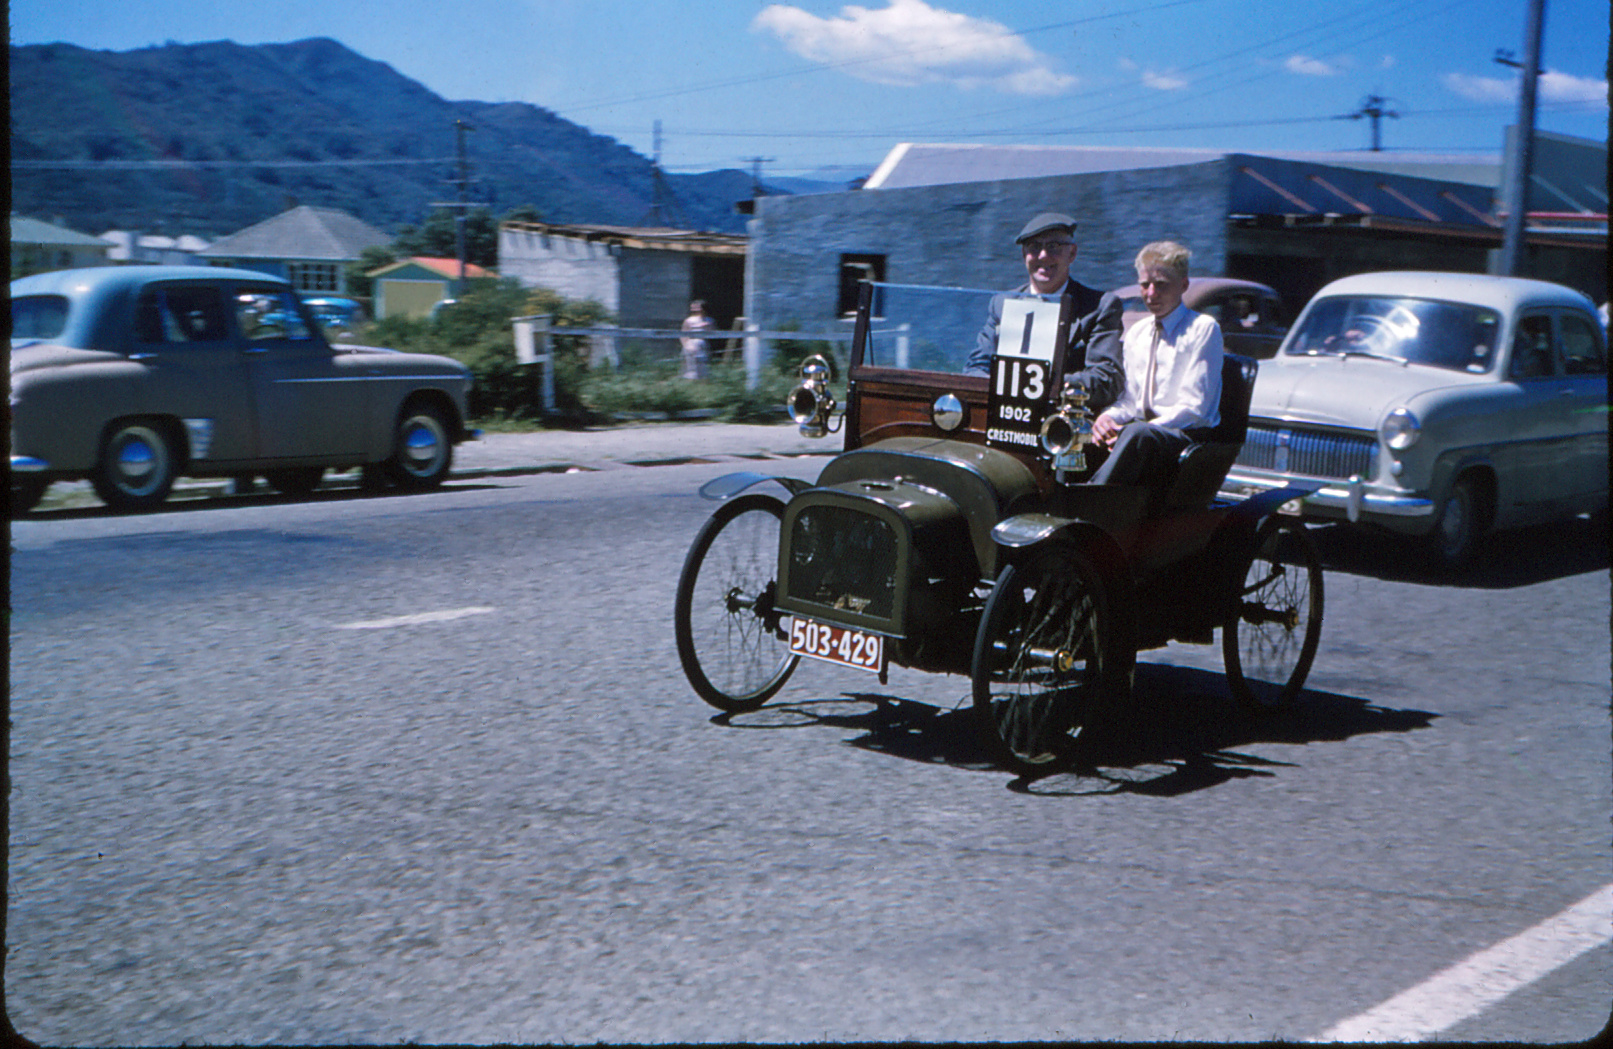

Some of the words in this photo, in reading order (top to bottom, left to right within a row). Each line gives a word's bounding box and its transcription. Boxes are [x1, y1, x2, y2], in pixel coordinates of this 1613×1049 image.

[1019, 311, 1035, 354] 1
[996, 360, 1044, 400] 113
[999, 405, 1032, 422] 1902
